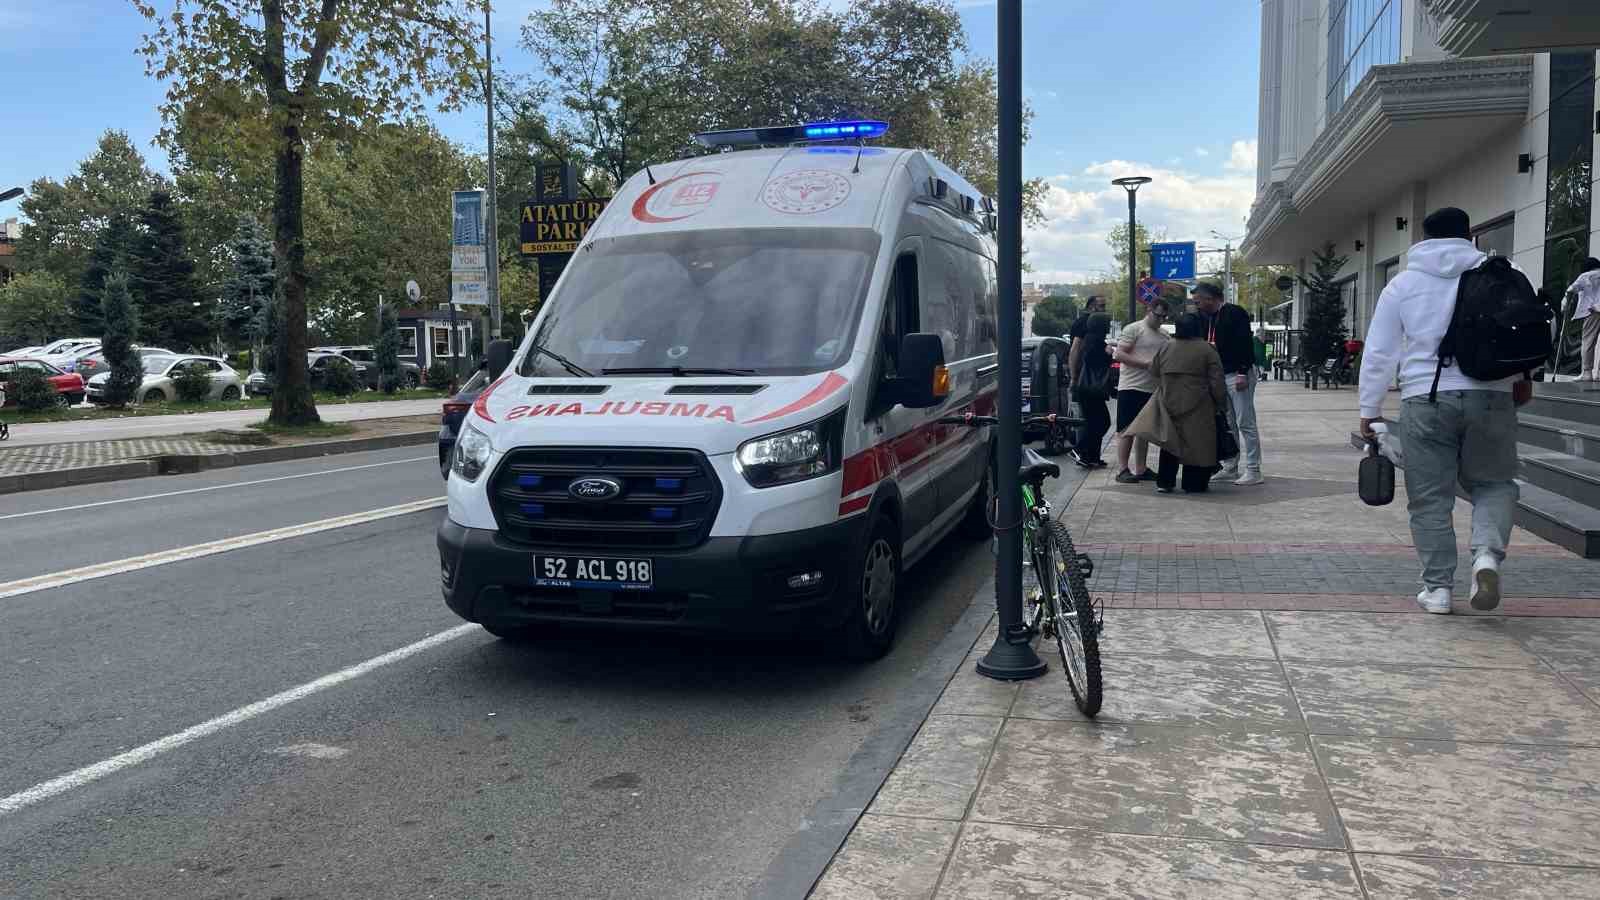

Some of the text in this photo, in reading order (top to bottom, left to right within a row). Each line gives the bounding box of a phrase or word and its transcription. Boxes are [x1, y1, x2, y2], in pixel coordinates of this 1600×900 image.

[578, 481, 608, 495] Ford
[544, 558, 650, 581] 52 ACL 918
